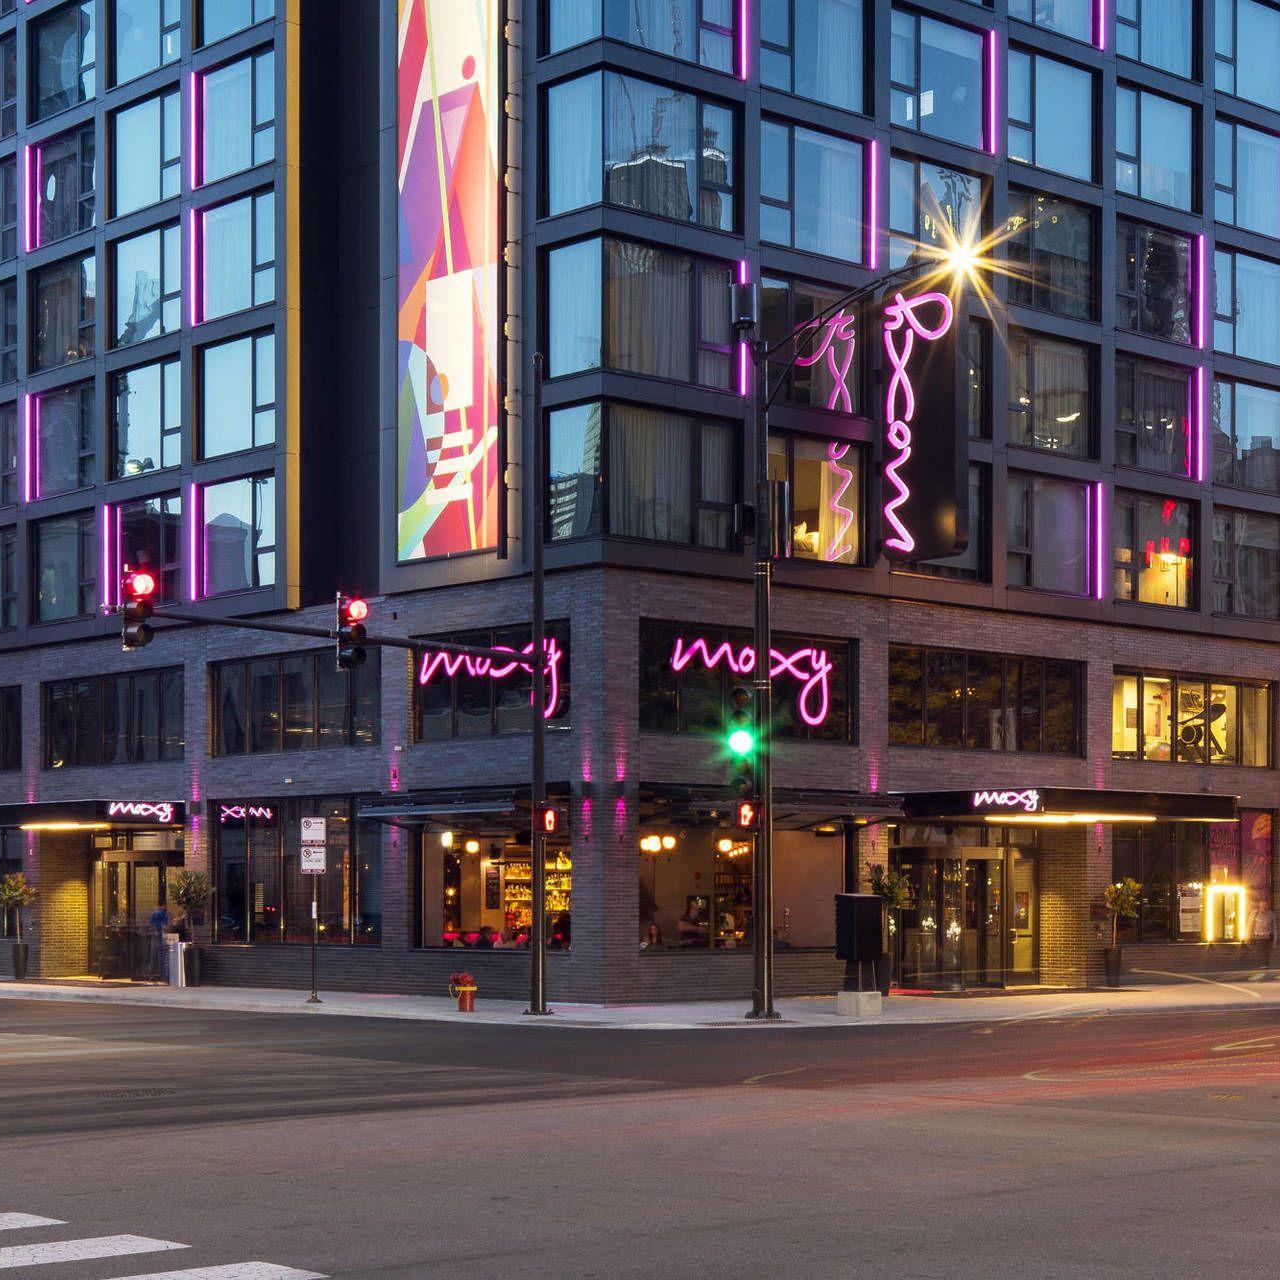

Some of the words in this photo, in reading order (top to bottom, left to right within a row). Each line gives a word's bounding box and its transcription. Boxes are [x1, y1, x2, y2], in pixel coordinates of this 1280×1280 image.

[884, 292, 953, 552] moxy
[672, 638, 832, 726] moxy
[109, 801, 174, 822] moxy
[973, 789, 1040, 812] moxy
